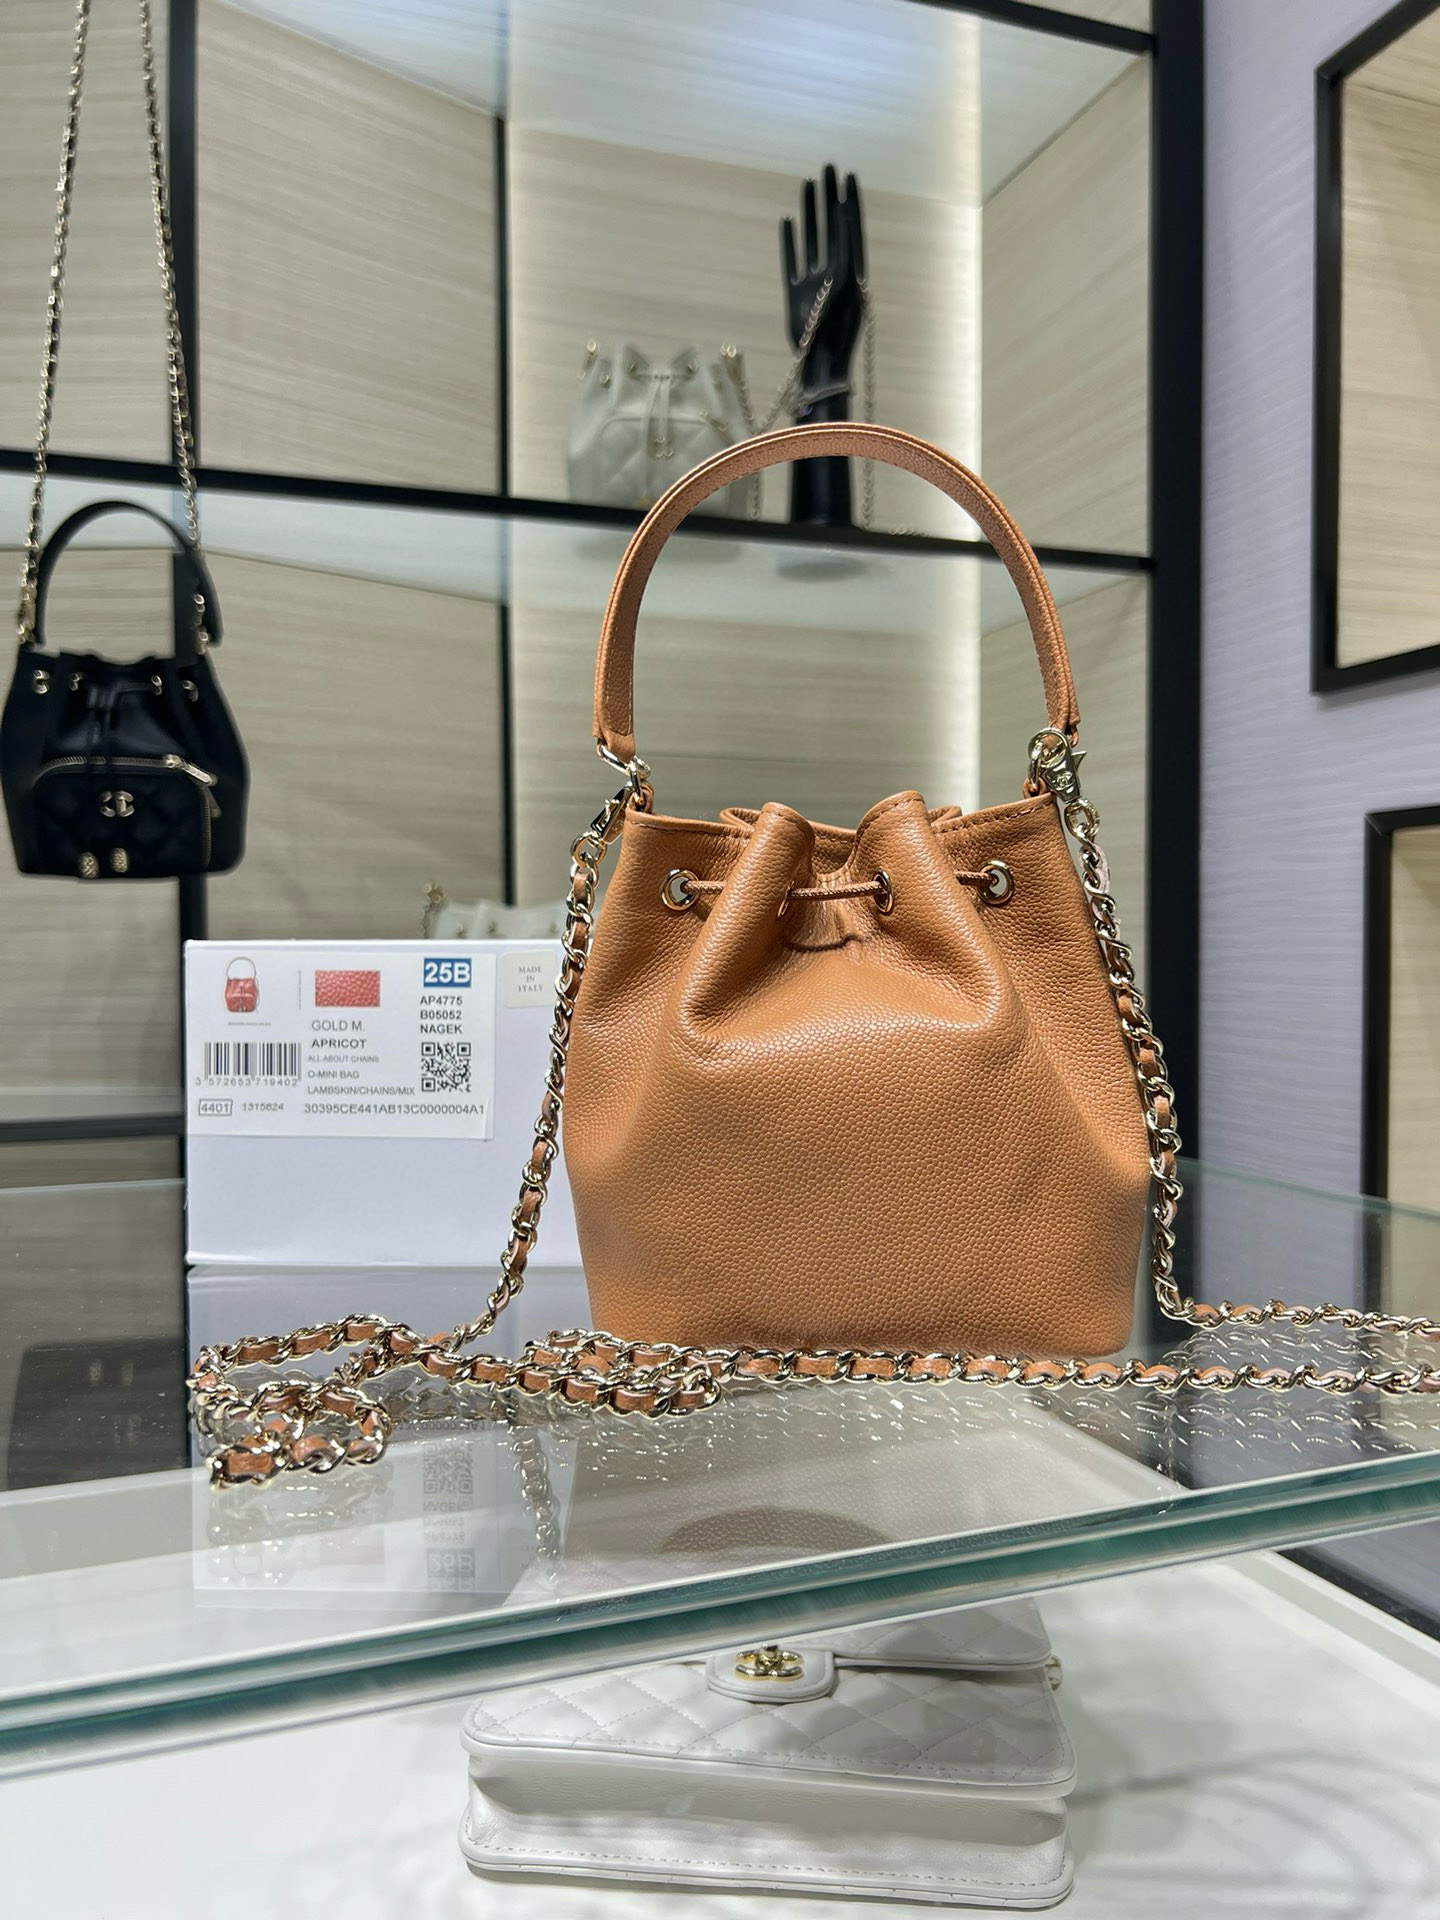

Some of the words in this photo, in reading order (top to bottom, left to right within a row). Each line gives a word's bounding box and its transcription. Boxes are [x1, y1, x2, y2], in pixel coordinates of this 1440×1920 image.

[424, 962, 471, 983] 25B
[518, 966, 543, 974] MADE
[526, 975, 536, 983] IN
[518, 983, 544, 992] ITALY
[420, 995, 463, 1006] AP4775
[420, 1009, 462, 1020] B05052
[311, 1019, 348, 1032] GOLD
[351, 1020, 366, 1032] M.
[420, 1023, 463, 1034] NAGEK
[311, 1038, 367, 1049] APRICOT
[307, 1055, 321, 1063] ALL
[323, 1055, 349, 1063] ABOUT
[350, 1055, 380, 1064] CHAINS
[339, 1069, 360, 1080] BAG
[255, 1077, 298, 1087] 719402
[307, 1085, 416, 1096] LAMBSKIN/CHAINS/MIX
[201, 1103, 229, 1113] 4401
